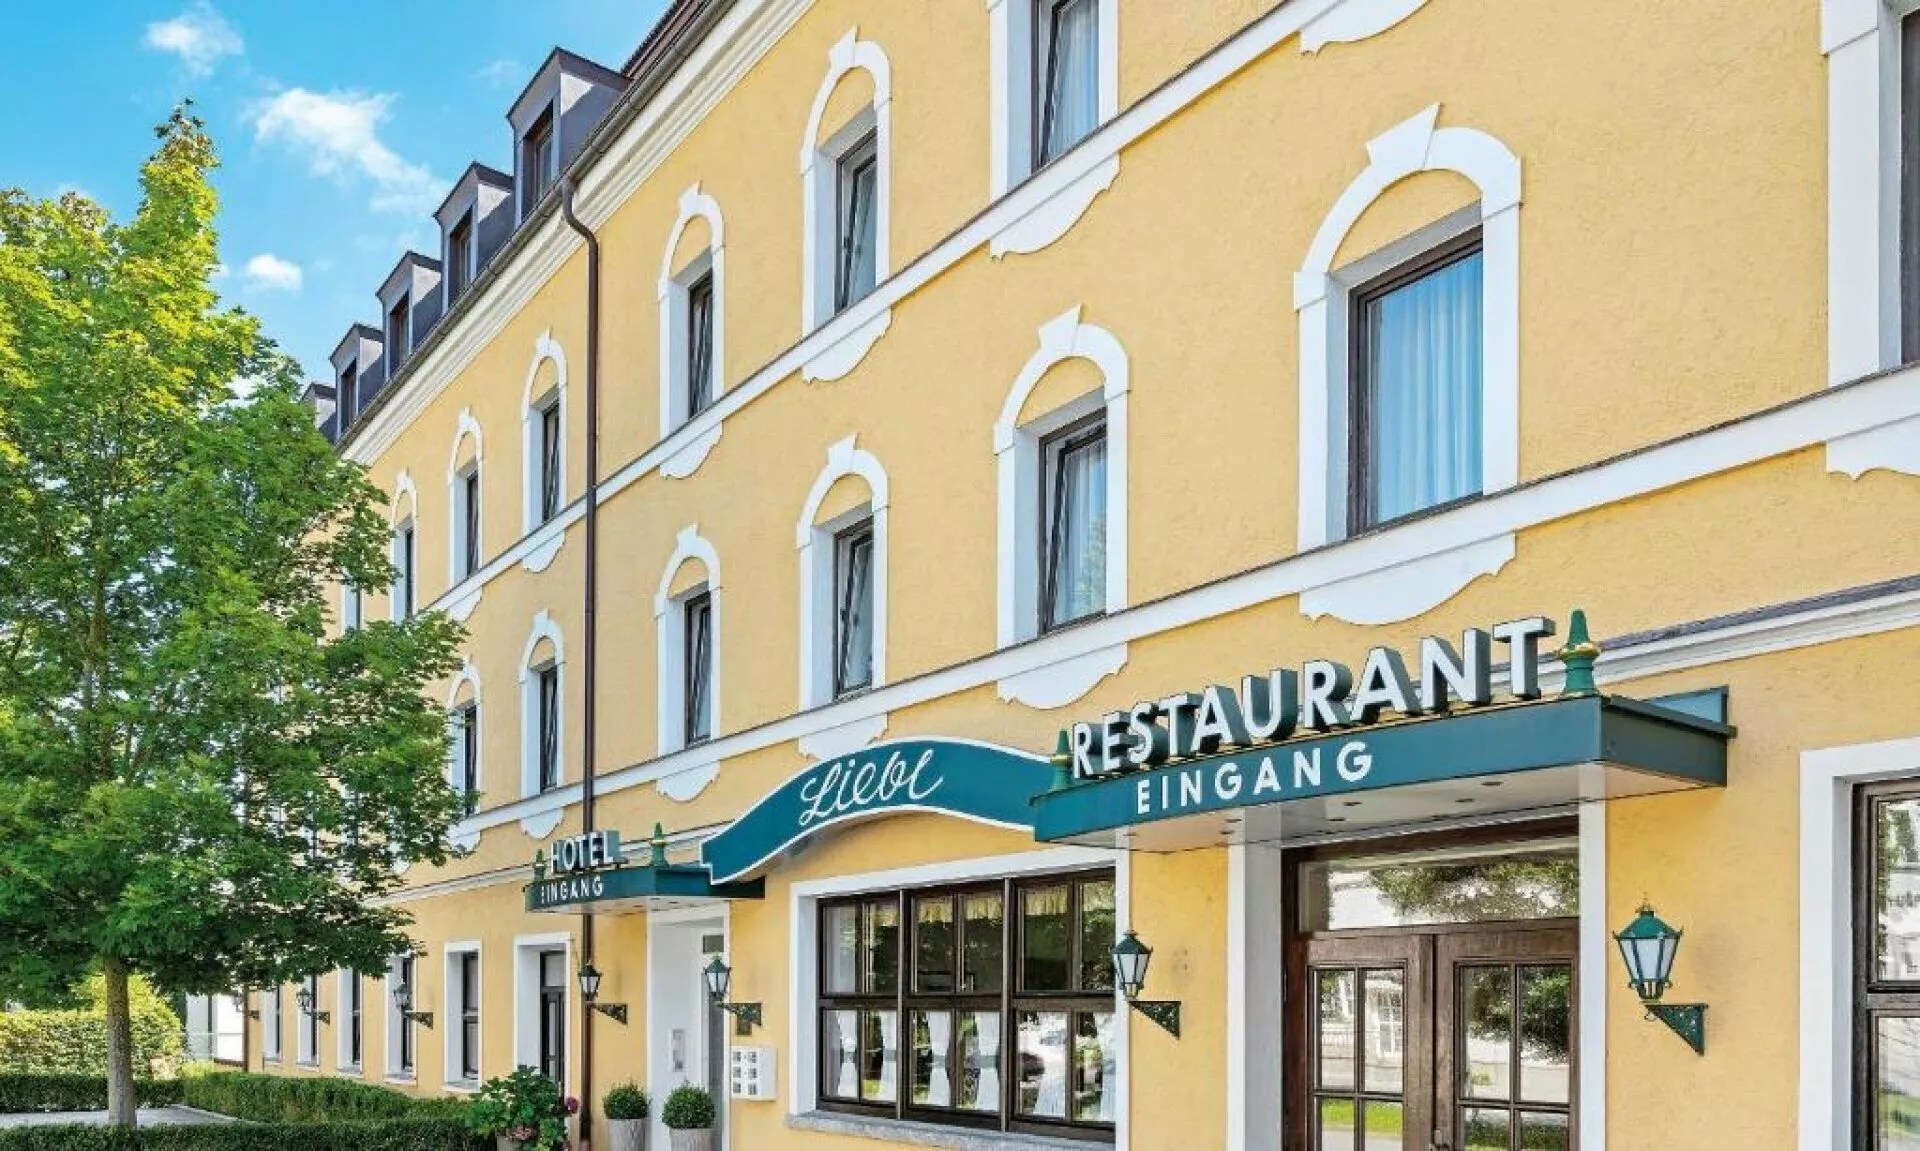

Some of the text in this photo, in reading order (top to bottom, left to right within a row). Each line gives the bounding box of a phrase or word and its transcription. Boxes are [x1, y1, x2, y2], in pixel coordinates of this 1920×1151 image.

[1072, 616, 1551, 779] RESTAURANT
[799, 749, 944, 825] Liebl
[1137, 741, 1373, 815] EINGANG
[551, 831, 616, 873] HOTEL
[541, 876, 604, 904] EINGANG
